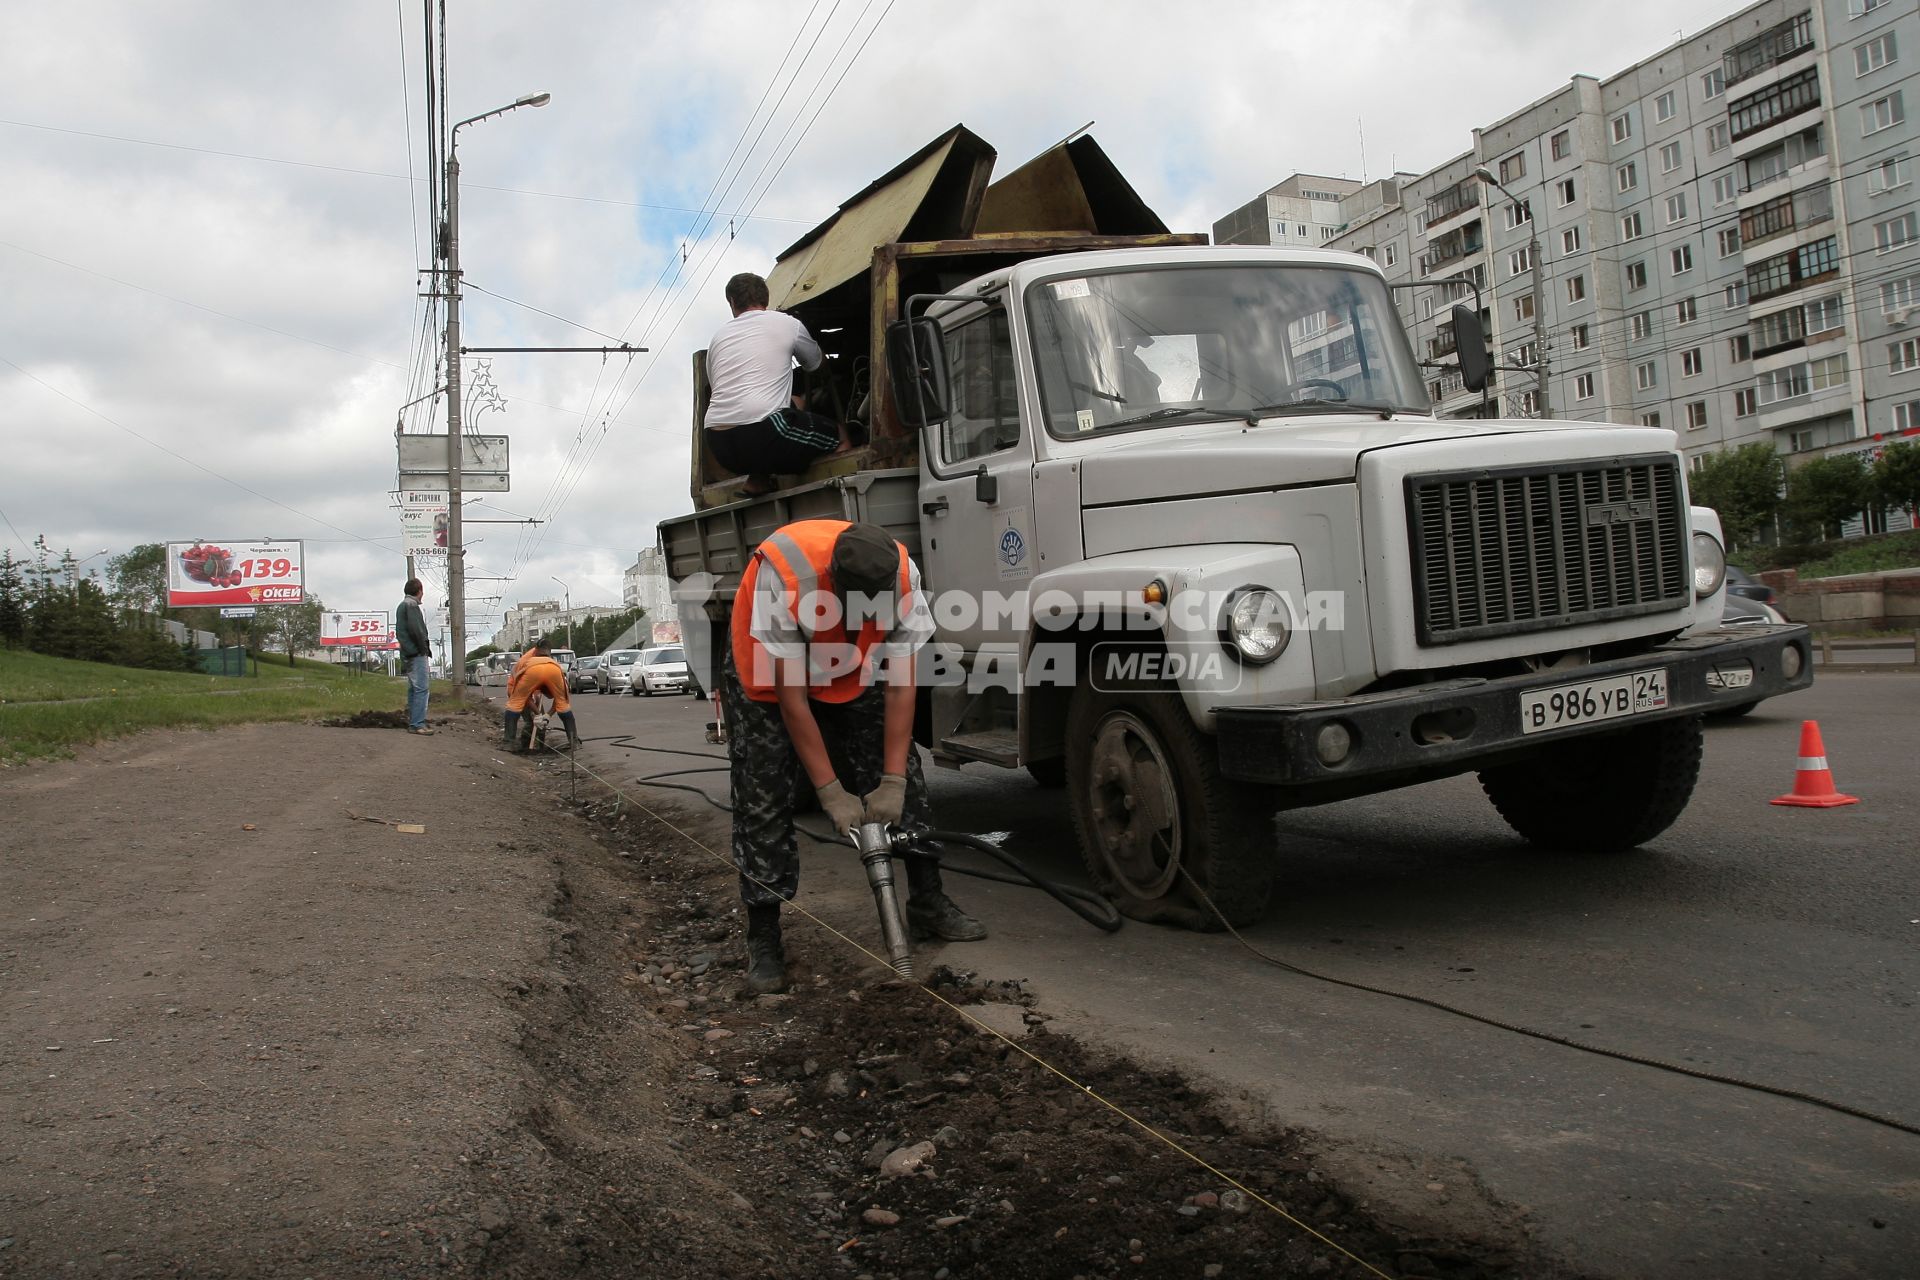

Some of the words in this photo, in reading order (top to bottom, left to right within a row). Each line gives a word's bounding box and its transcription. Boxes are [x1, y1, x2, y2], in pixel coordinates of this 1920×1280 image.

[1587, 500, 1652, 524] ГАЗ
[409, 547, 447, 555] 2-555-666
[1635, 673, 1660, 699] 24
[1635, 699, 1653, 709] RUS
